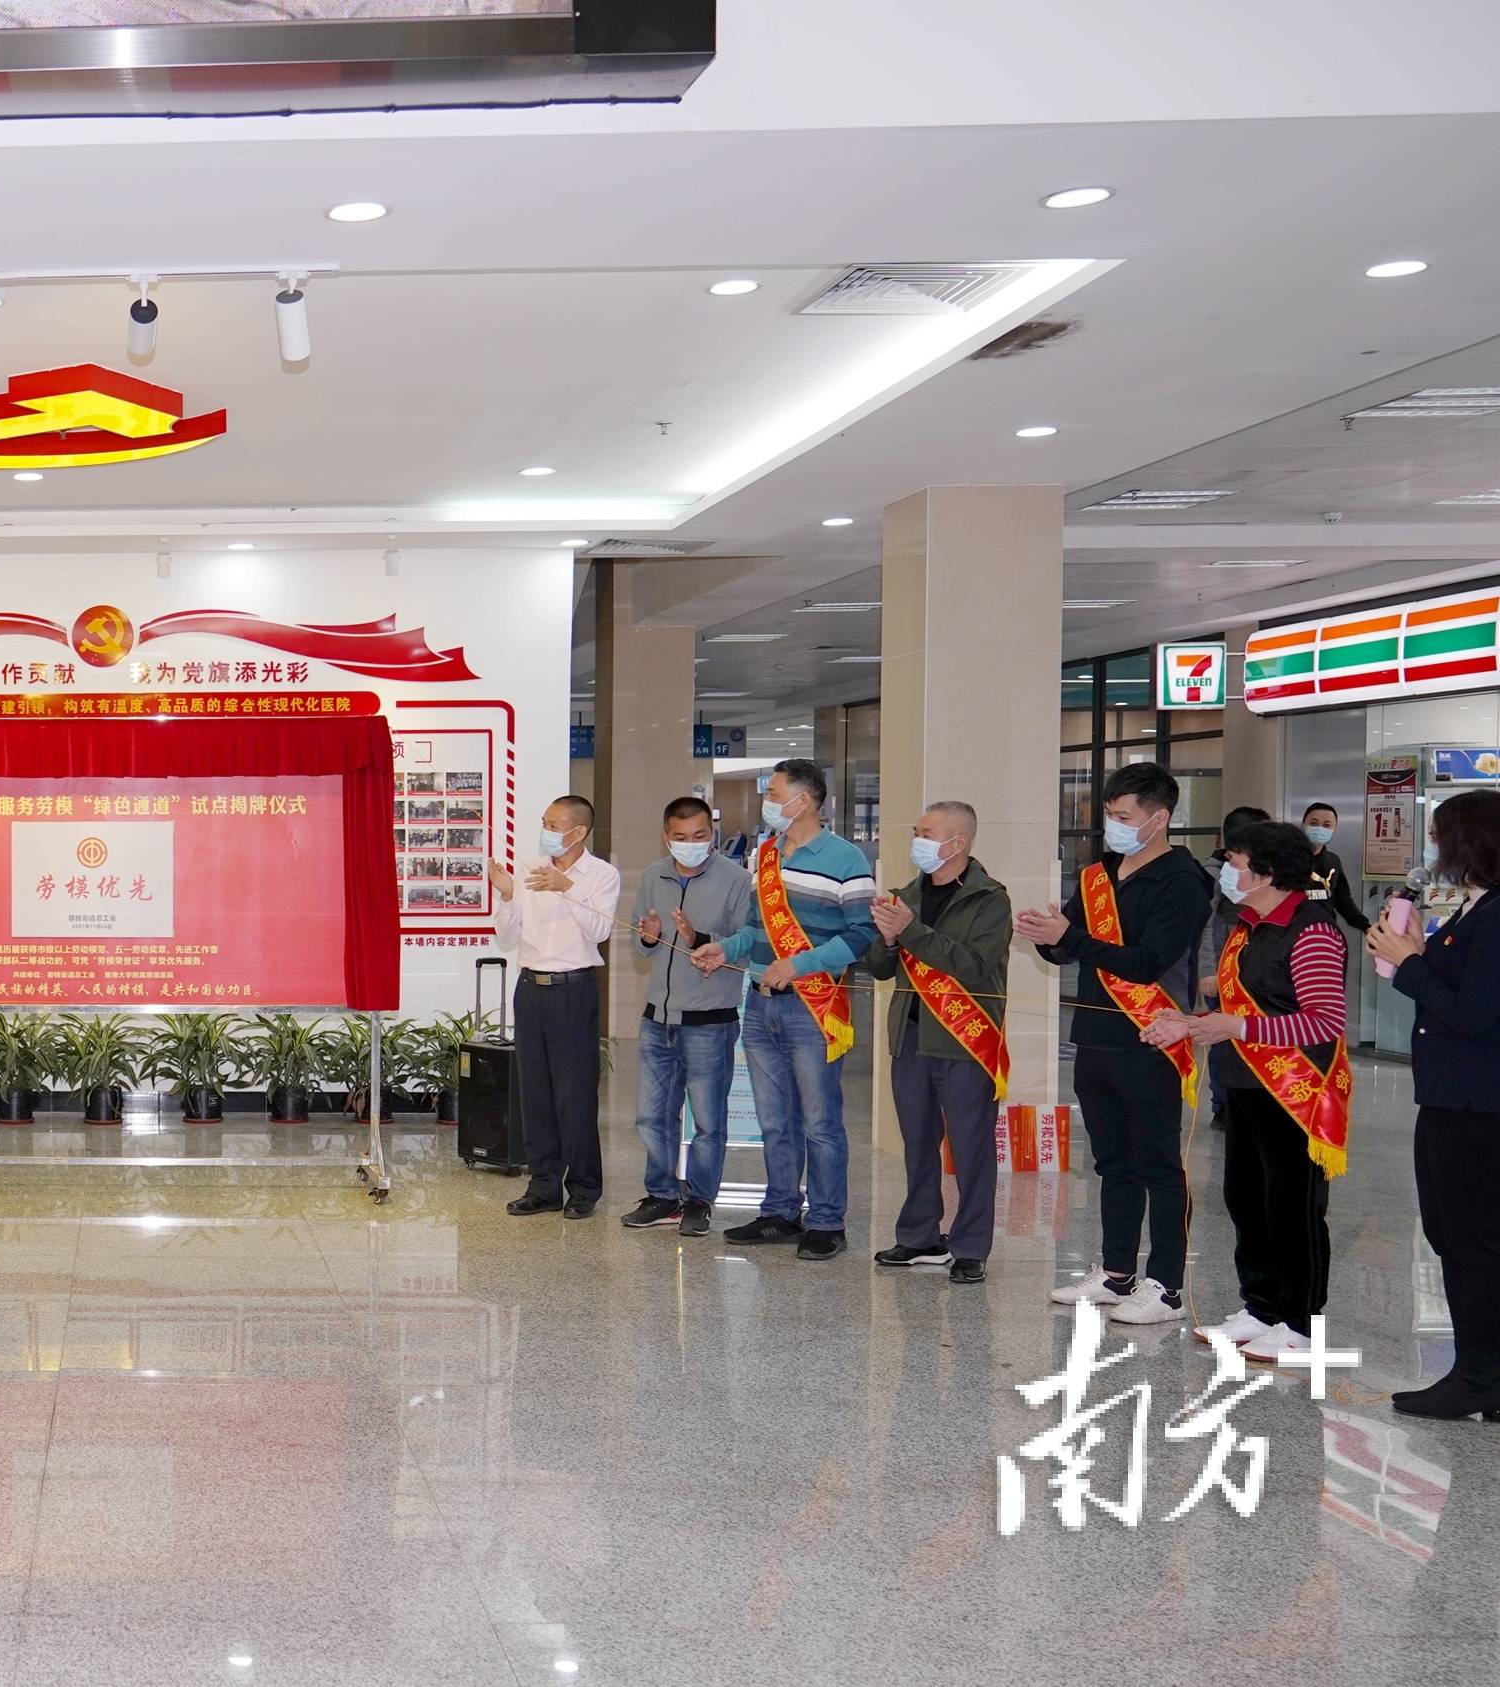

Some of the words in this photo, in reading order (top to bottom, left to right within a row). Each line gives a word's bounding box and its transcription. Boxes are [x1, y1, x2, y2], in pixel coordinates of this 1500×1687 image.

[129, 660, 309, 684] 我为党旗添光彩
[36, 873, 153, 902] 劳模优先
[904, 950, 988, 1038] 模范致敬
